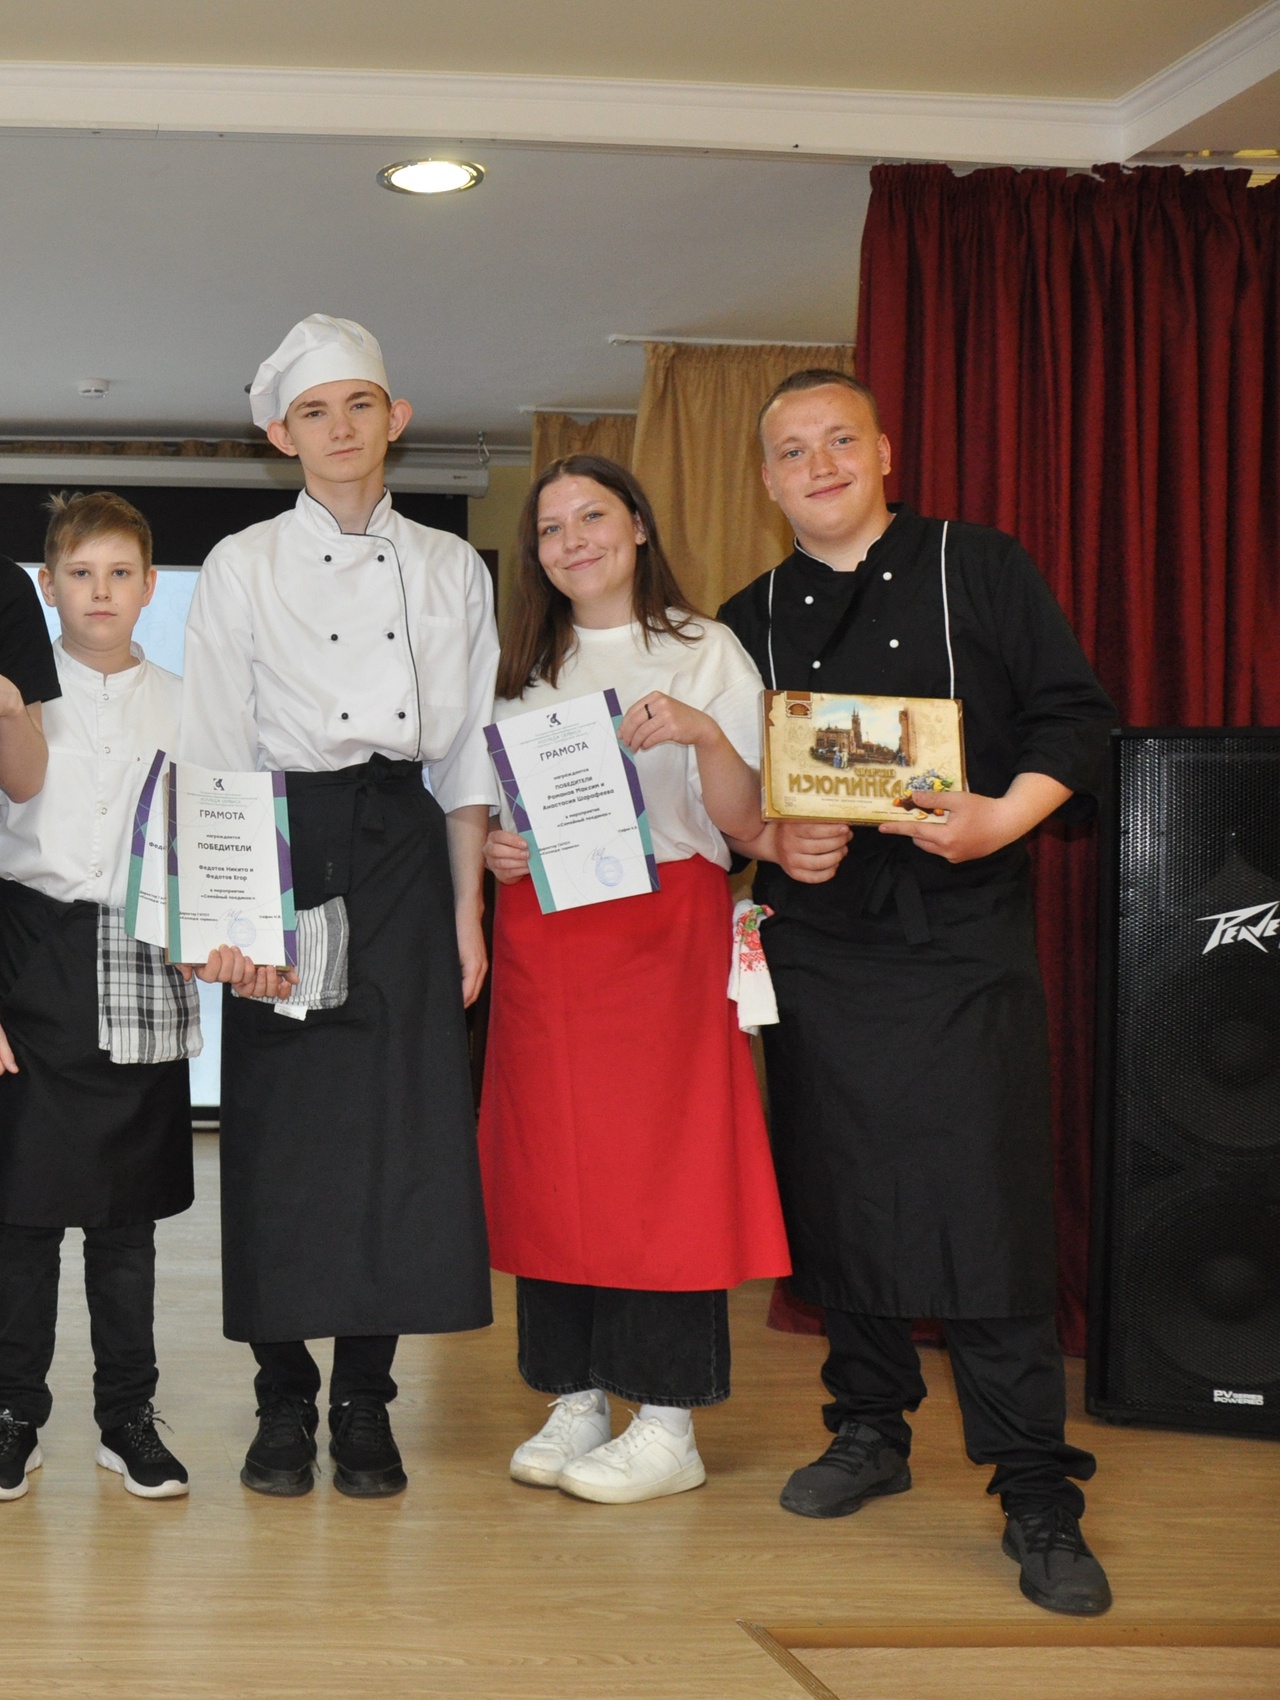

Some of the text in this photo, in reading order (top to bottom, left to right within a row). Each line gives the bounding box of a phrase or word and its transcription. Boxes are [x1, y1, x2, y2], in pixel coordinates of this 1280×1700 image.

[540, 741, 589, 761] ГРАМОТА
[553, 768, 589, 780] награждается
[555, 776, 592, 790] ПОБЕДИТЕЛИ
[788, 773, 904, 798] ИЗЮМИНКА
[547, 789, 574, 800] Романов
[575, 784, 599, 794] Максим
[543, 789, 615, 811] Анастасия Шарафеева
[199, 810, 245, 820] ГРАМОТА
[569, 808, 600, 819] мероприятии
[198, 842, 252, 852] ПОБЕДИТЕЛИ
[199, 865, 225, 873] Федотов
[206, 873, 248, 882] Федотов Егор
[1195, 900, 1280, 955] PEAVE
[1213, 1389, 1233, 1398] PV
